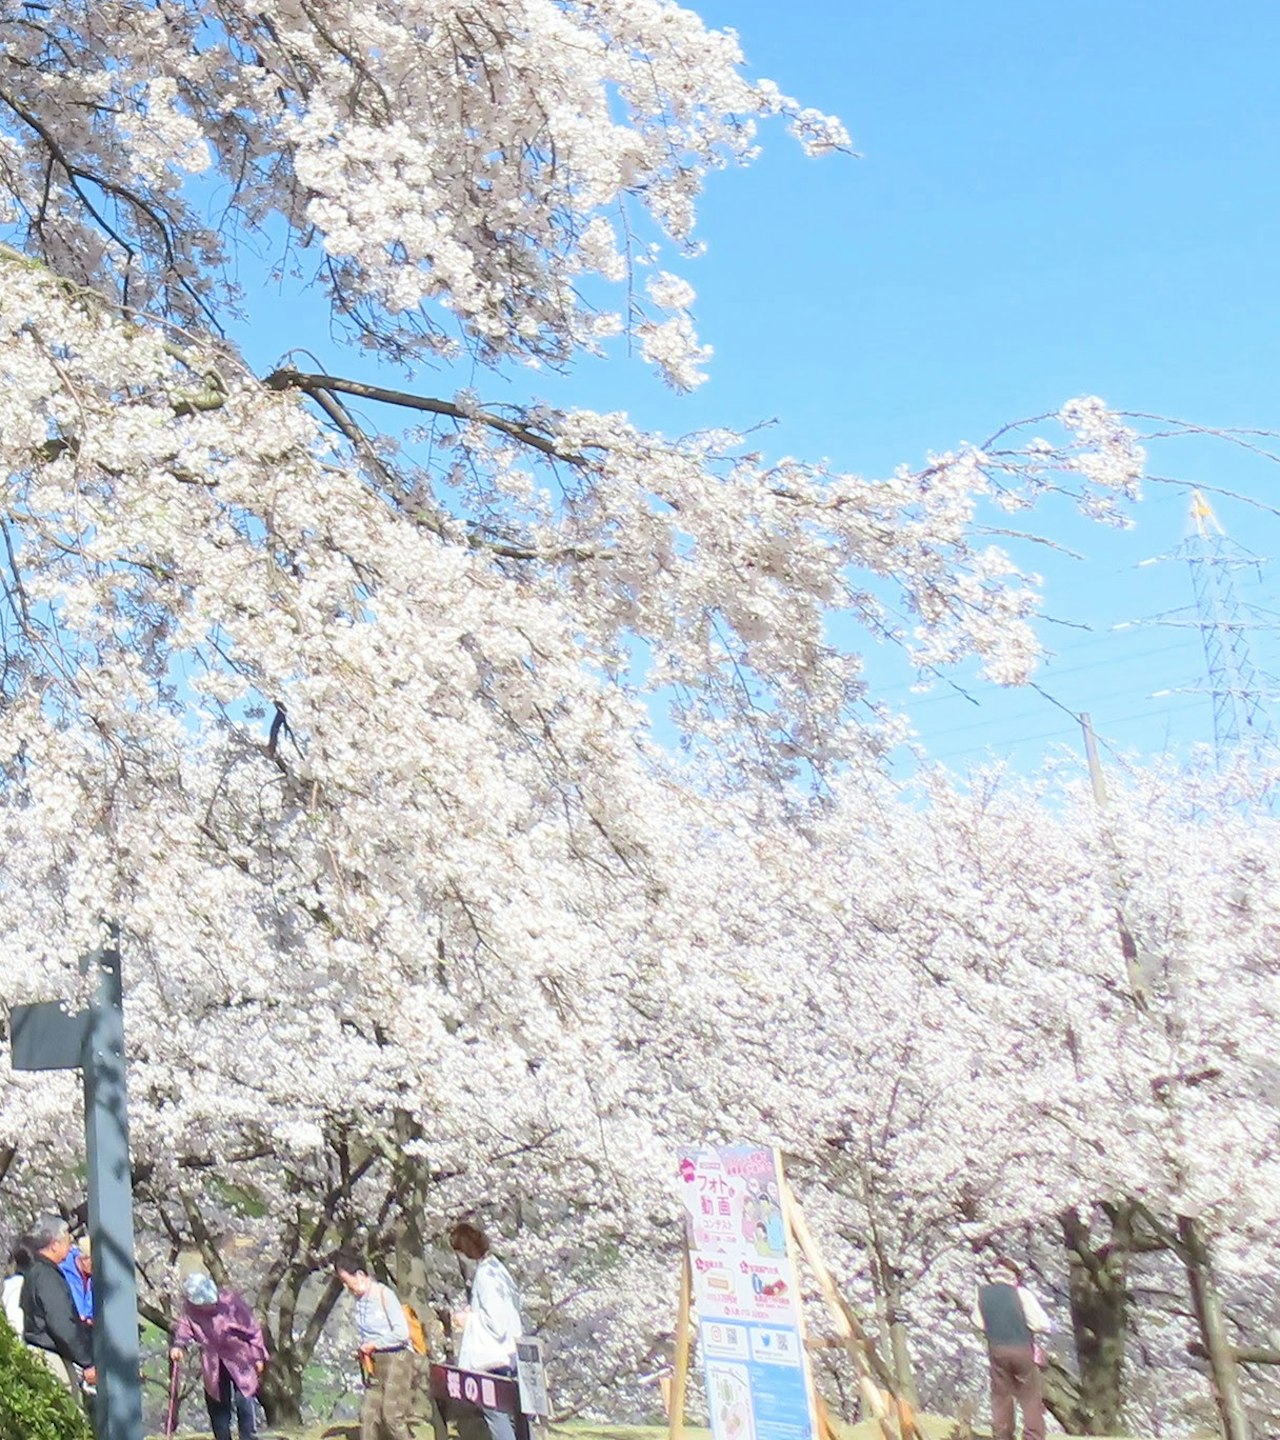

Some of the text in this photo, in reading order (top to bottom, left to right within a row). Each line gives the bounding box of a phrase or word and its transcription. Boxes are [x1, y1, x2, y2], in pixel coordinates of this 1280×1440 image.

[697, 1174, 728, 1194] フォト
[700, 1195, 731, 1216] 動画
